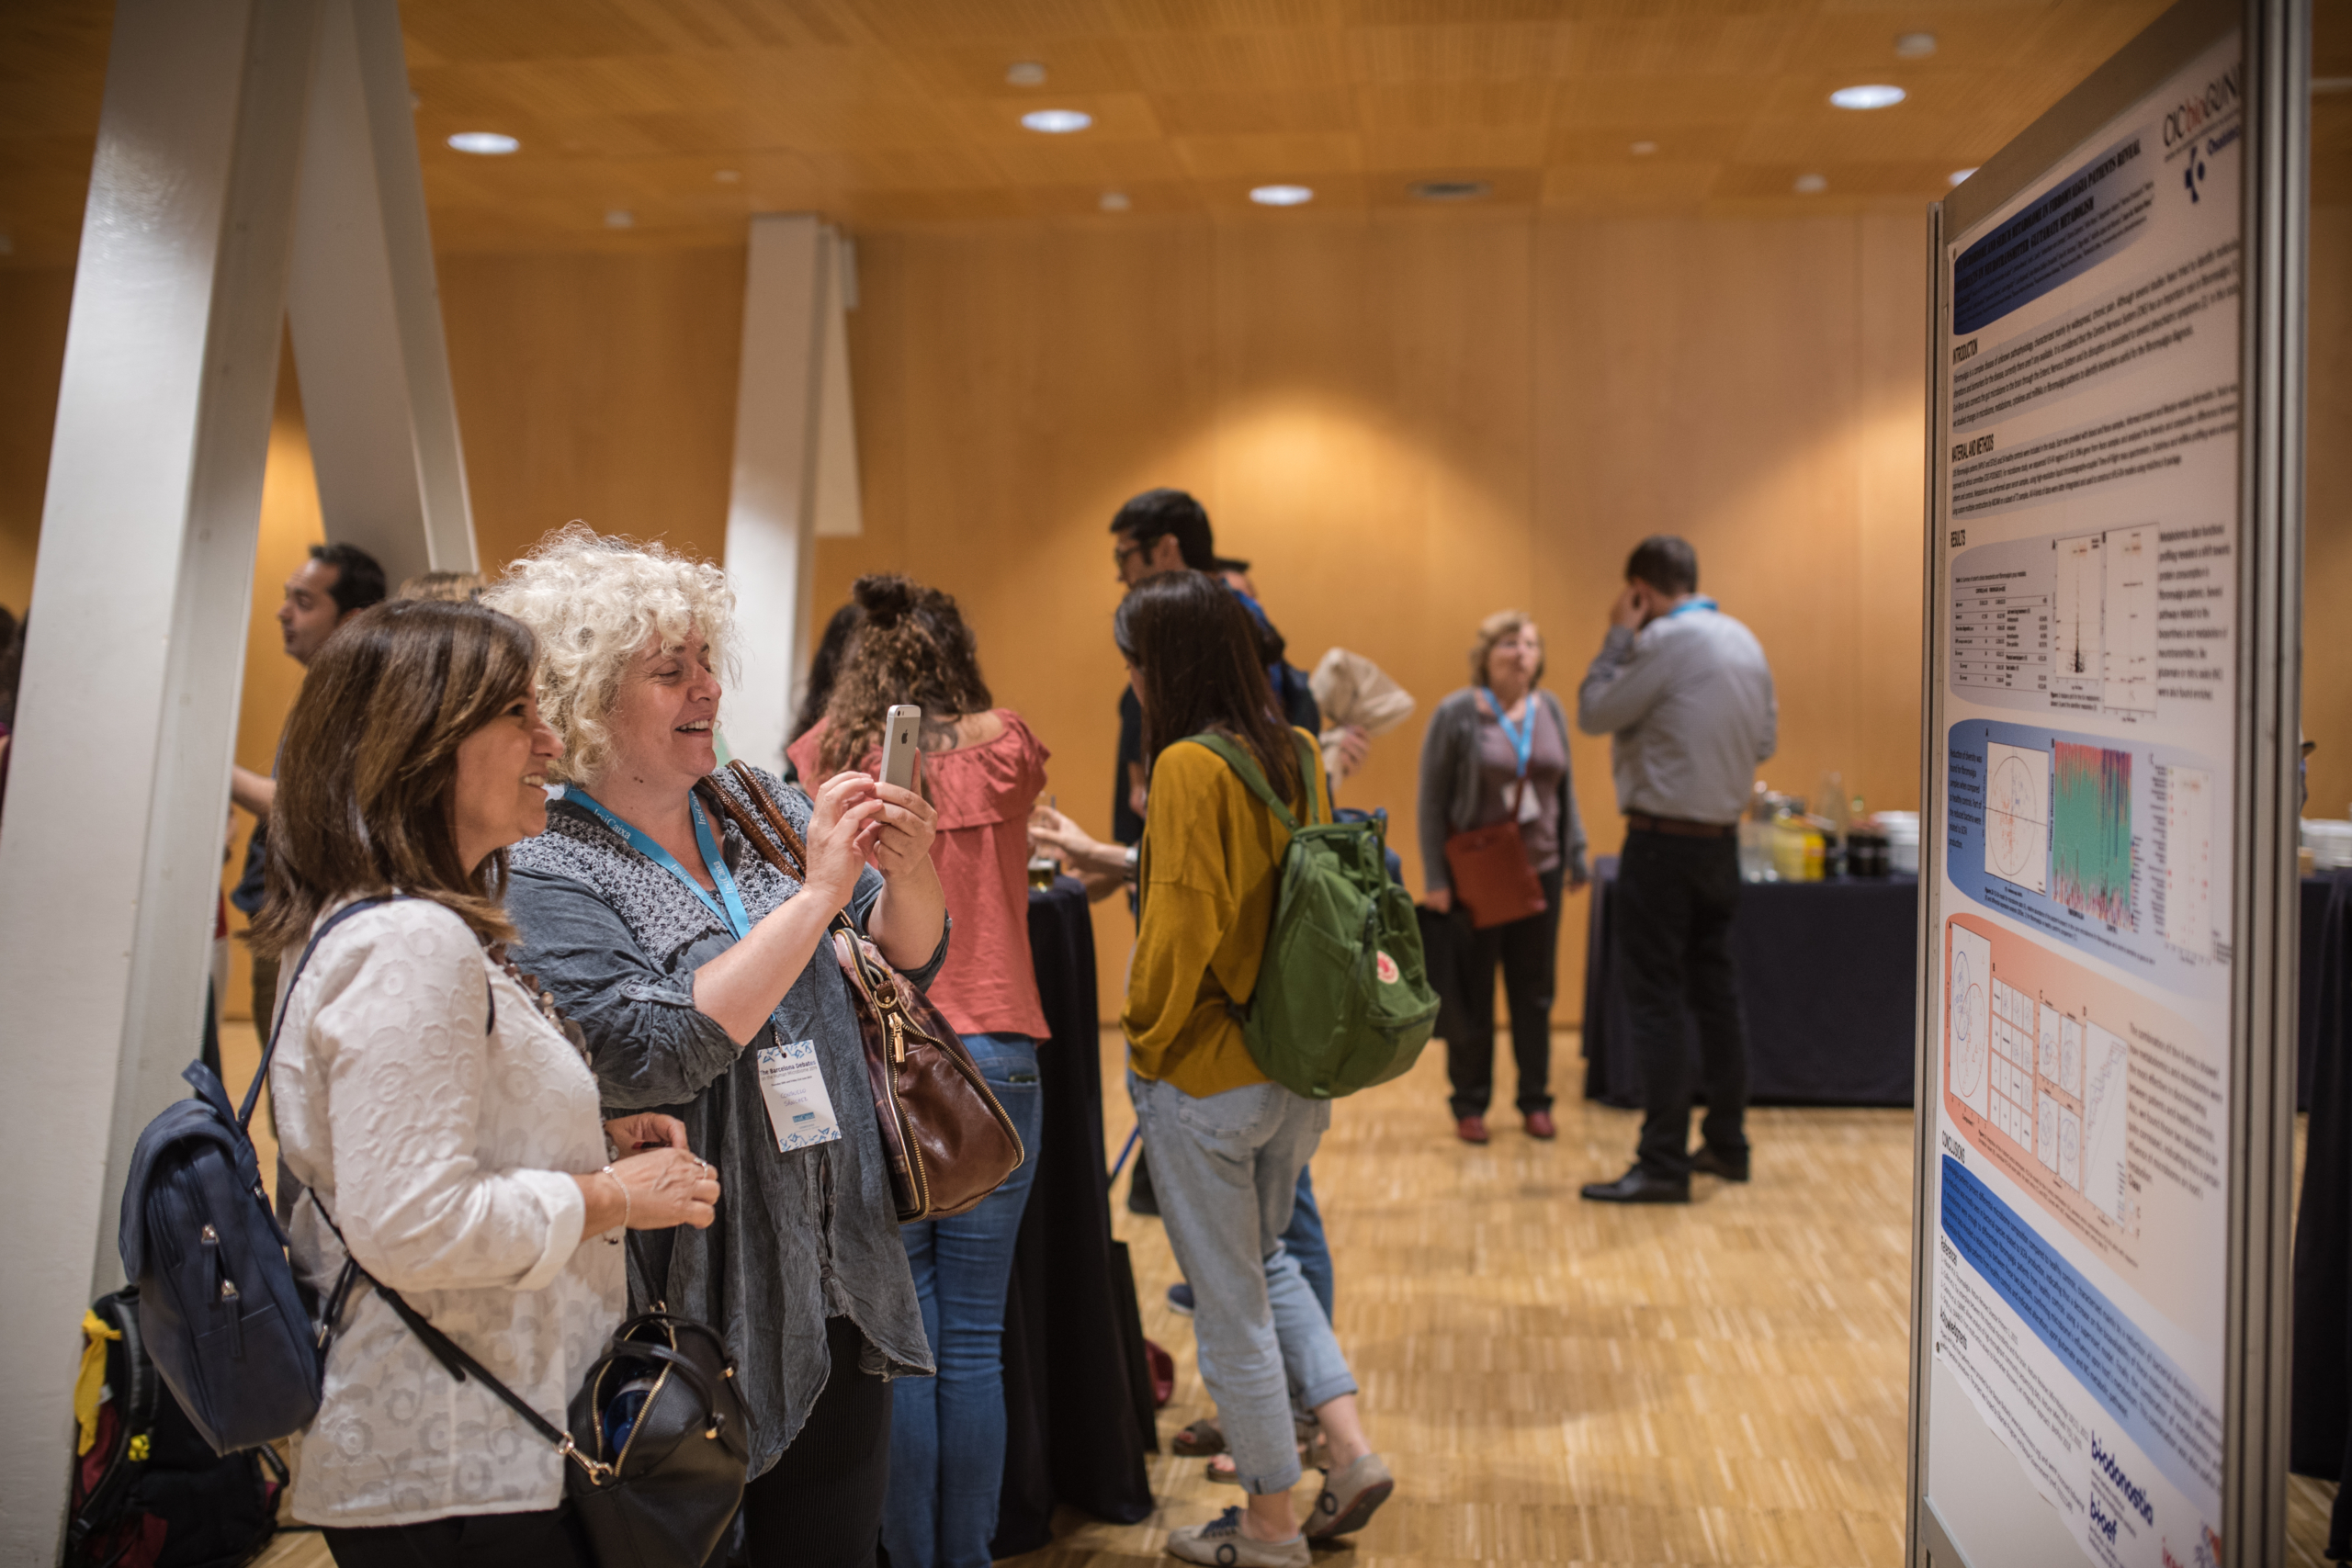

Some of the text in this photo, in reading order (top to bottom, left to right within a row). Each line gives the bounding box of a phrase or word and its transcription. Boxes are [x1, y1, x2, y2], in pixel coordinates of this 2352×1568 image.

[1952, 336, 1977, 366] INTRODUCTION
[1951, 441, 1967, 463] MATERIAL
[1976, 432, 1994, 455] METHODS
[1951, 528, 1965, 547] RESULTS
[594, 808, 631, 840] IrsiCaixa
[670, 863, 705, 897] IrsiCaixa
[713, 861, 734, 895] IrsiCaixa
[769, 1065, 795, 1075] Barcelona
[795, 1060, 816, 1069] Debates
[787, 1067, 808, 1076] Microbiome
[1941, 1129, 1964, 1164] CONCLUSIONS
[1940, 1234, 1957, 1267] References
[2091, 1429, 2154, 1529] biodonostia
[2090, 1490, 2118, 1547] bioef
